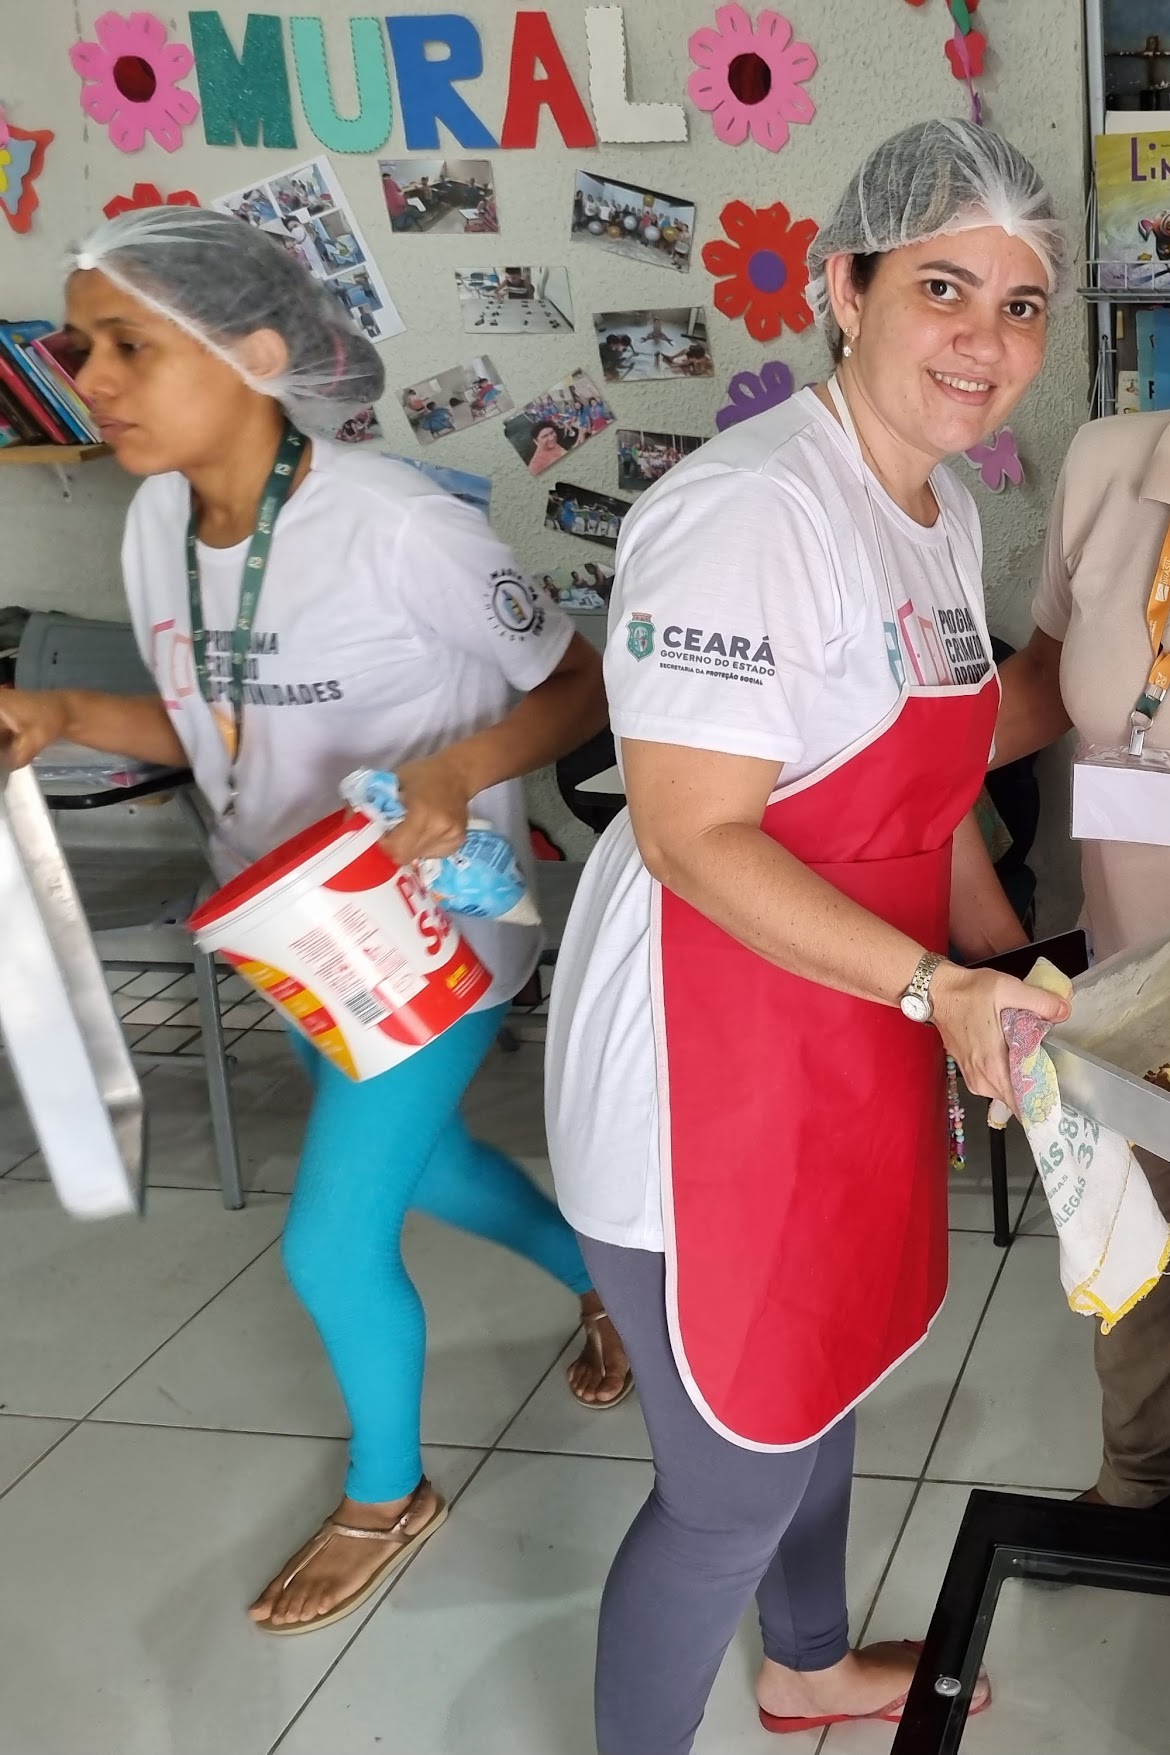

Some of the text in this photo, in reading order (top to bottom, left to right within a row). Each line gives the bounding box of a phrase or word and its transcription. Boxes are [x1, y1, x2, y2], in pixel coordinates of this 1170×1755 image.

[188, 6, 689, 153] MURAL
[662, 625, 776, 667] CEARÁ
[659, 662, 694, 673] SECRETARIA
[706, 670, 739, 681] PROTEÇÃO
[740, 675, 763, 686] SOCIAL
[660, 650, 775, 677] GOVERNO DO ESTADO
